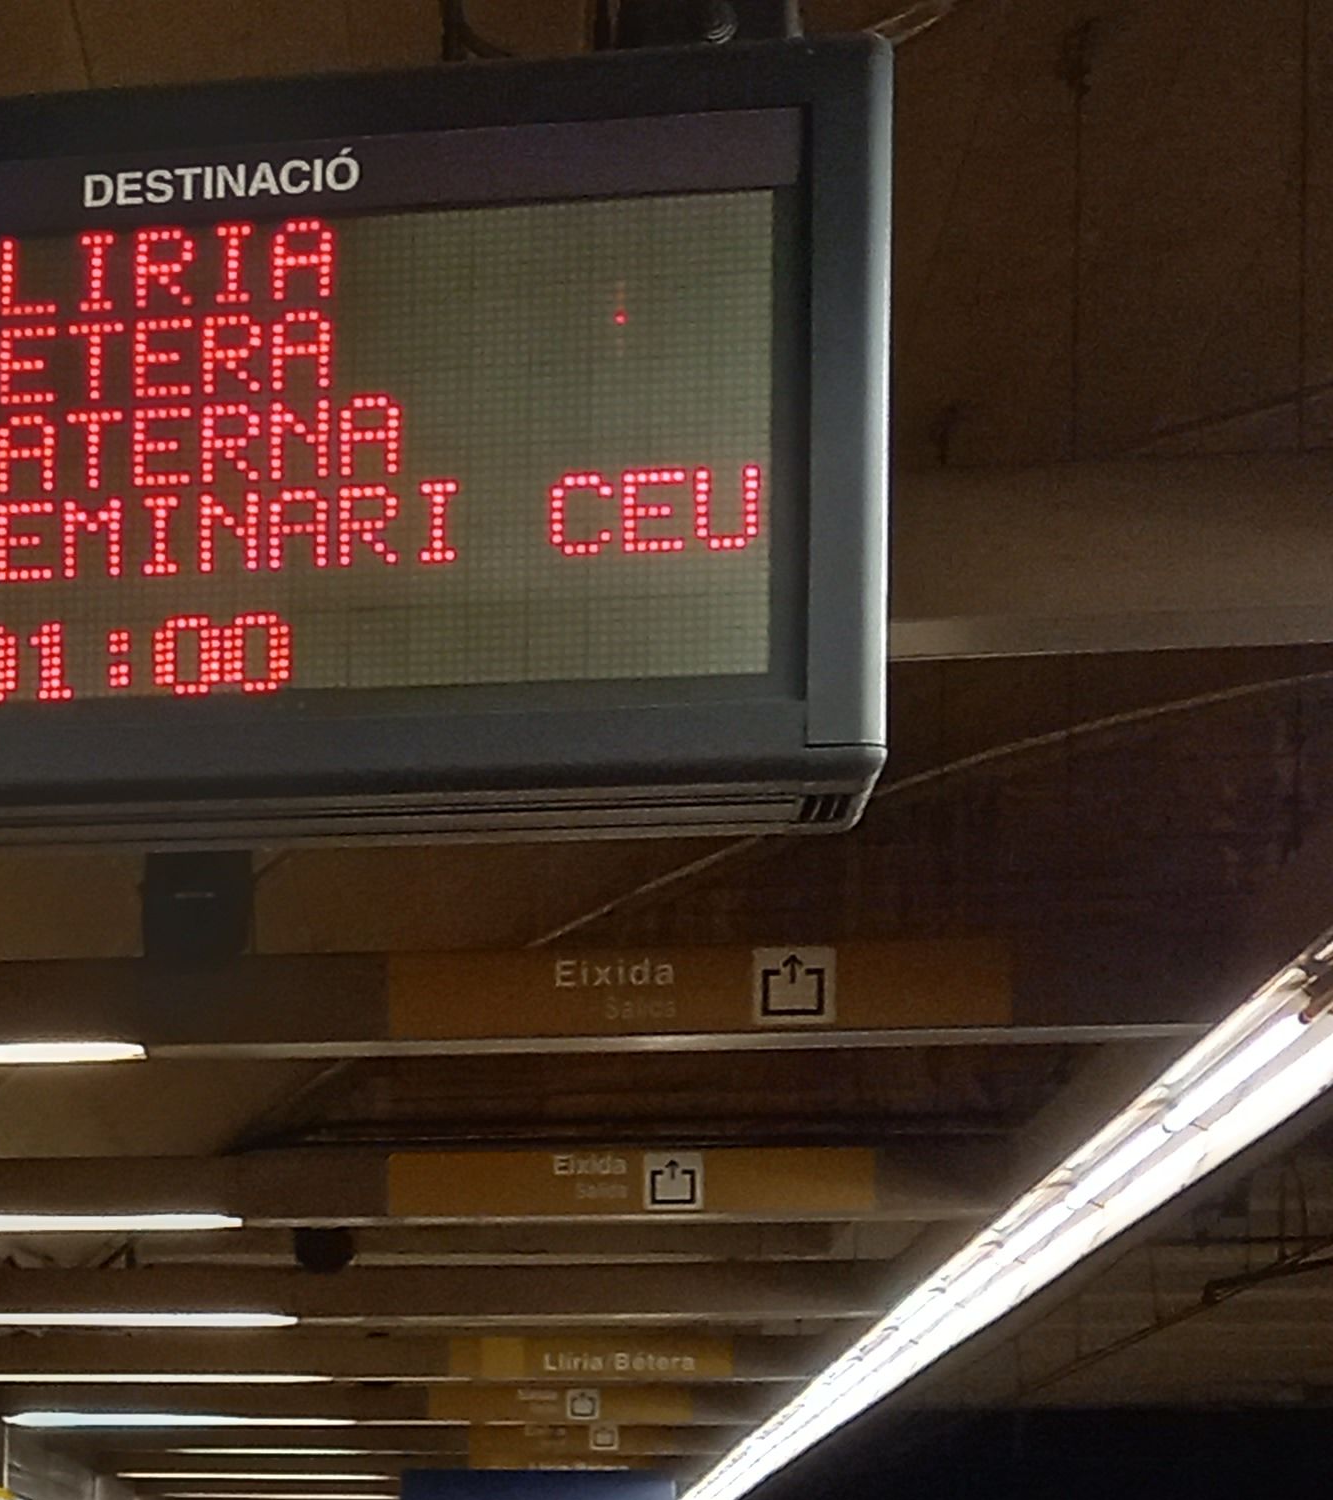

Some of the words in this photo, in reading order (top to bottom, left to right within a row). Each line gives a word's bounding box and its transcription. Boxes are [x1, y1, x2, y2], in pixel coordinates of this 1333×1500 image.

[84, 148, 360, 208] DESTINACIÓ
[550, 464, 761, 556] CEU
[555, 958, 675, 988] Eixida
